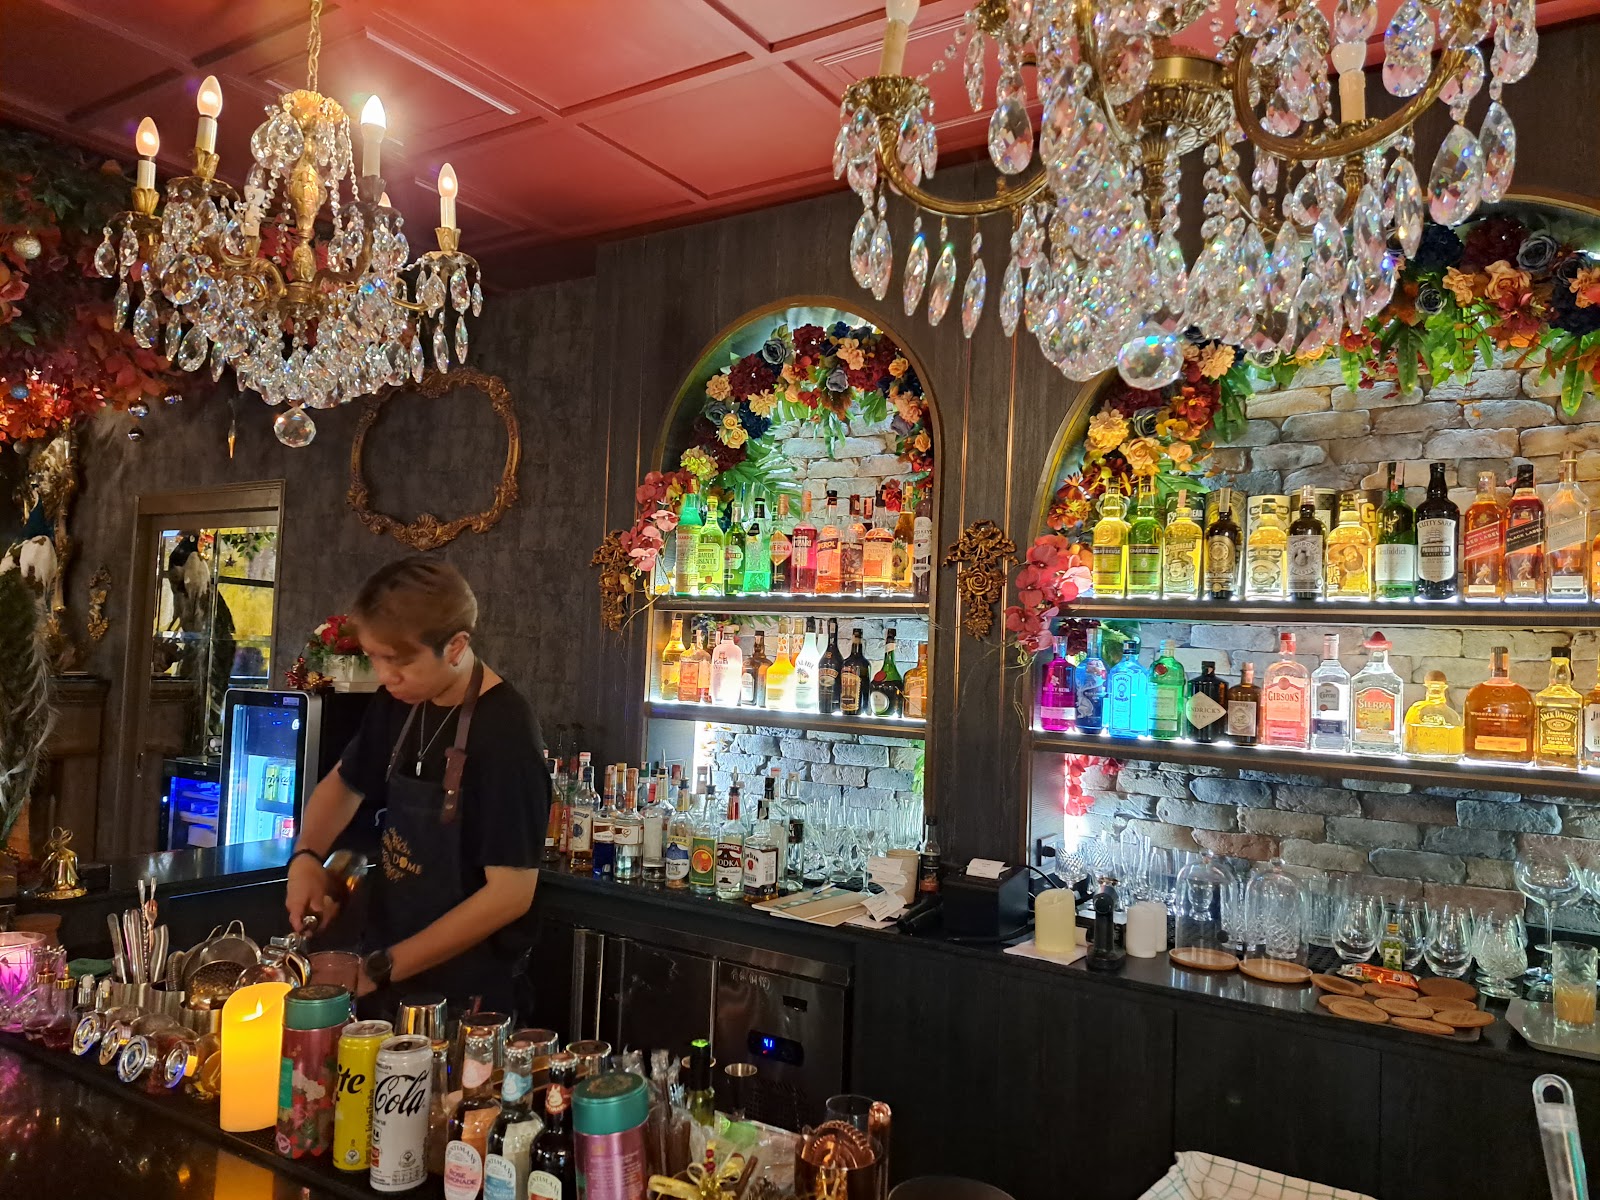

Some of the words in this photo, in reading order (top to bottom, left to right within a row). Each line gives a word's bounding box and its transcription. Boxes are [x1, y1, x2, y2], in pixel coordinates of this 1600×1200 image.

[1419, 520, 1436, 528] CUTTY
[1466, 538, 1479, 546] RED
[1480, 531, 1499, 541] LABEL
[1267, 691, 1299, 702] GIBSON'S
[1356, 699, 1392, 709] SIERRA
[1540, 711, 1554, 722] JACK
[718, 859, 739, 867] ODKA
